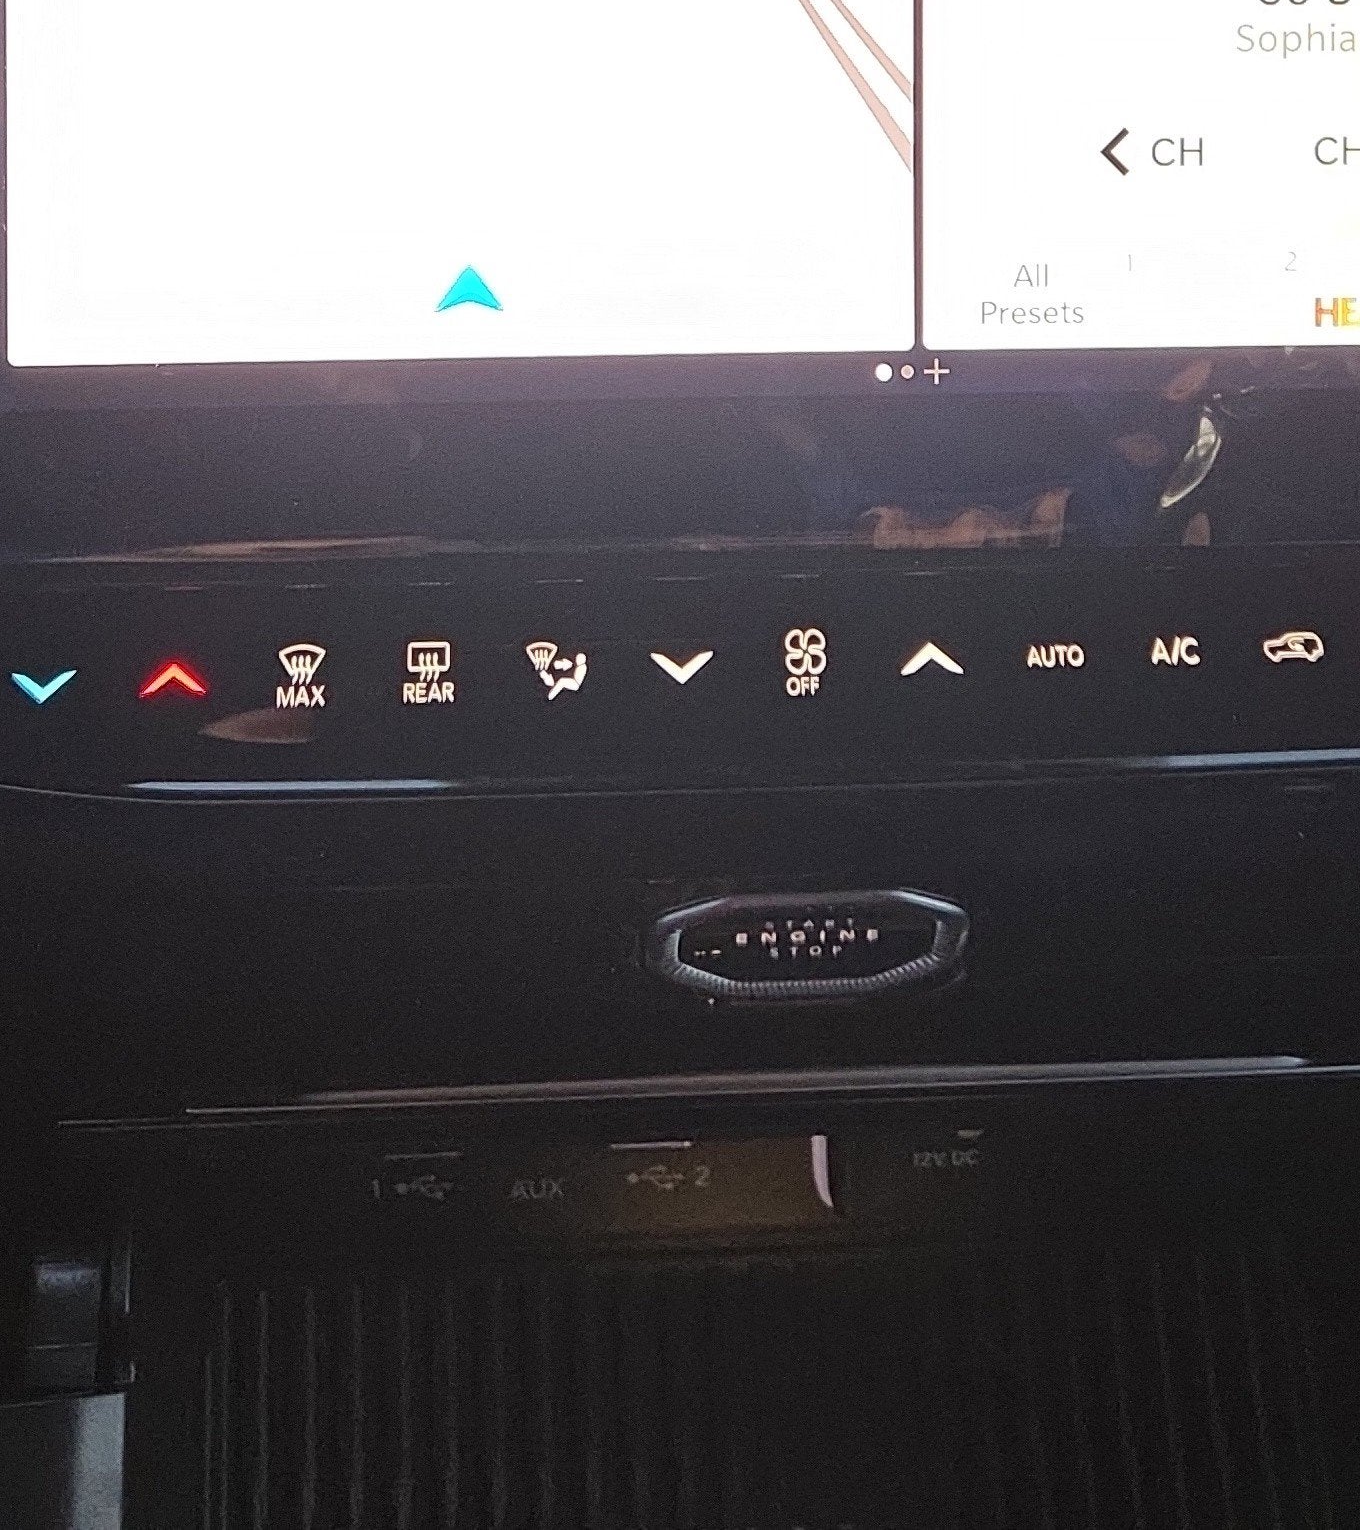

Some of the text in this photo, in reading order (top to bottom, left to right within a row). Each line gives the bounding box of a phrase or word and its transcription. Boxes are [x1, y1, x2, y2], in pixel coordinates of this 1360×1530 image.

[1235, 24, 1358, 58] Sophia
[1150, 136, 1205, 169] CH
[1014, 263, 1051, 289] All
[980, 299, 1086, 329] Presets
[1027, 645, 1085, 669] AUTO
[1150, 636, 1202, 667] A/C
[276, 686, 327, 709] MAX
[402, 682, 455, 705] REAR
[785, 677, 821, 698] OFF
[734, 928, 879, 946] ENGINE
[769, 945, 845, 960] STOP
[694, 1167, 712, 1189] 2
[507, 1179, 569, 1202] AUX
